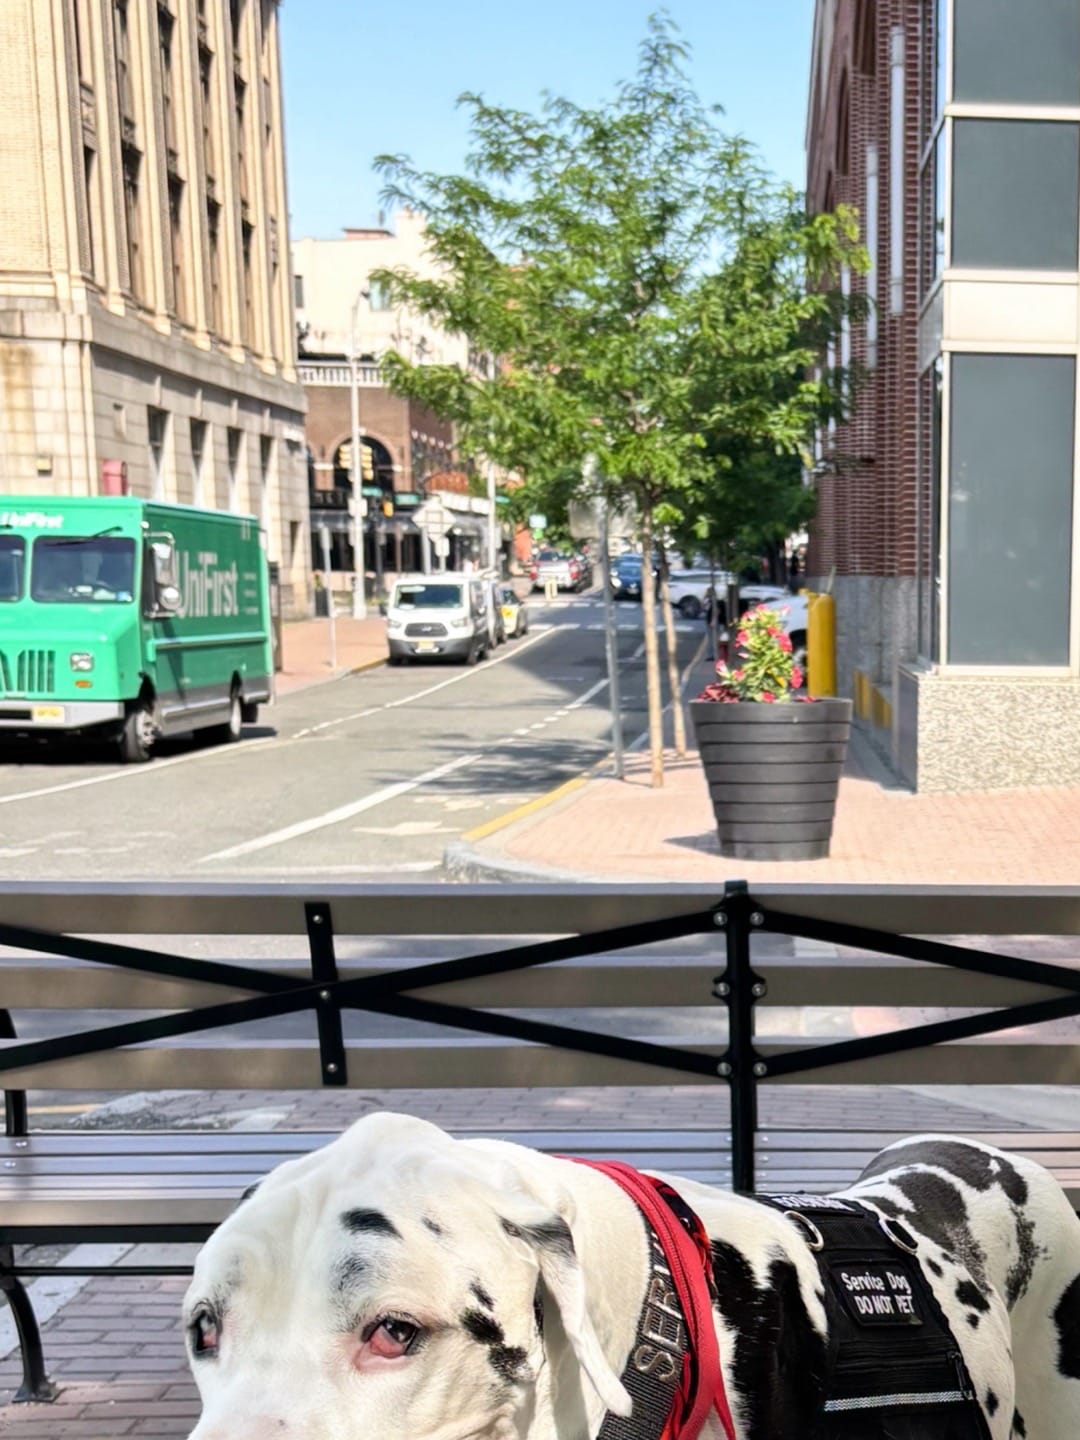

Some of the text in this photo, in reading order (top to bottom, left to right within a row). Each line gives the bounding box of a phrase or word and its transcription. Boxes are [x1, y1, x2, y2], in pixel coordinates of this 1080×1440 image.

[841, 1271, 912, 1295] Service Dog
[854, 1295, 915, 1314] DO NOT PET
